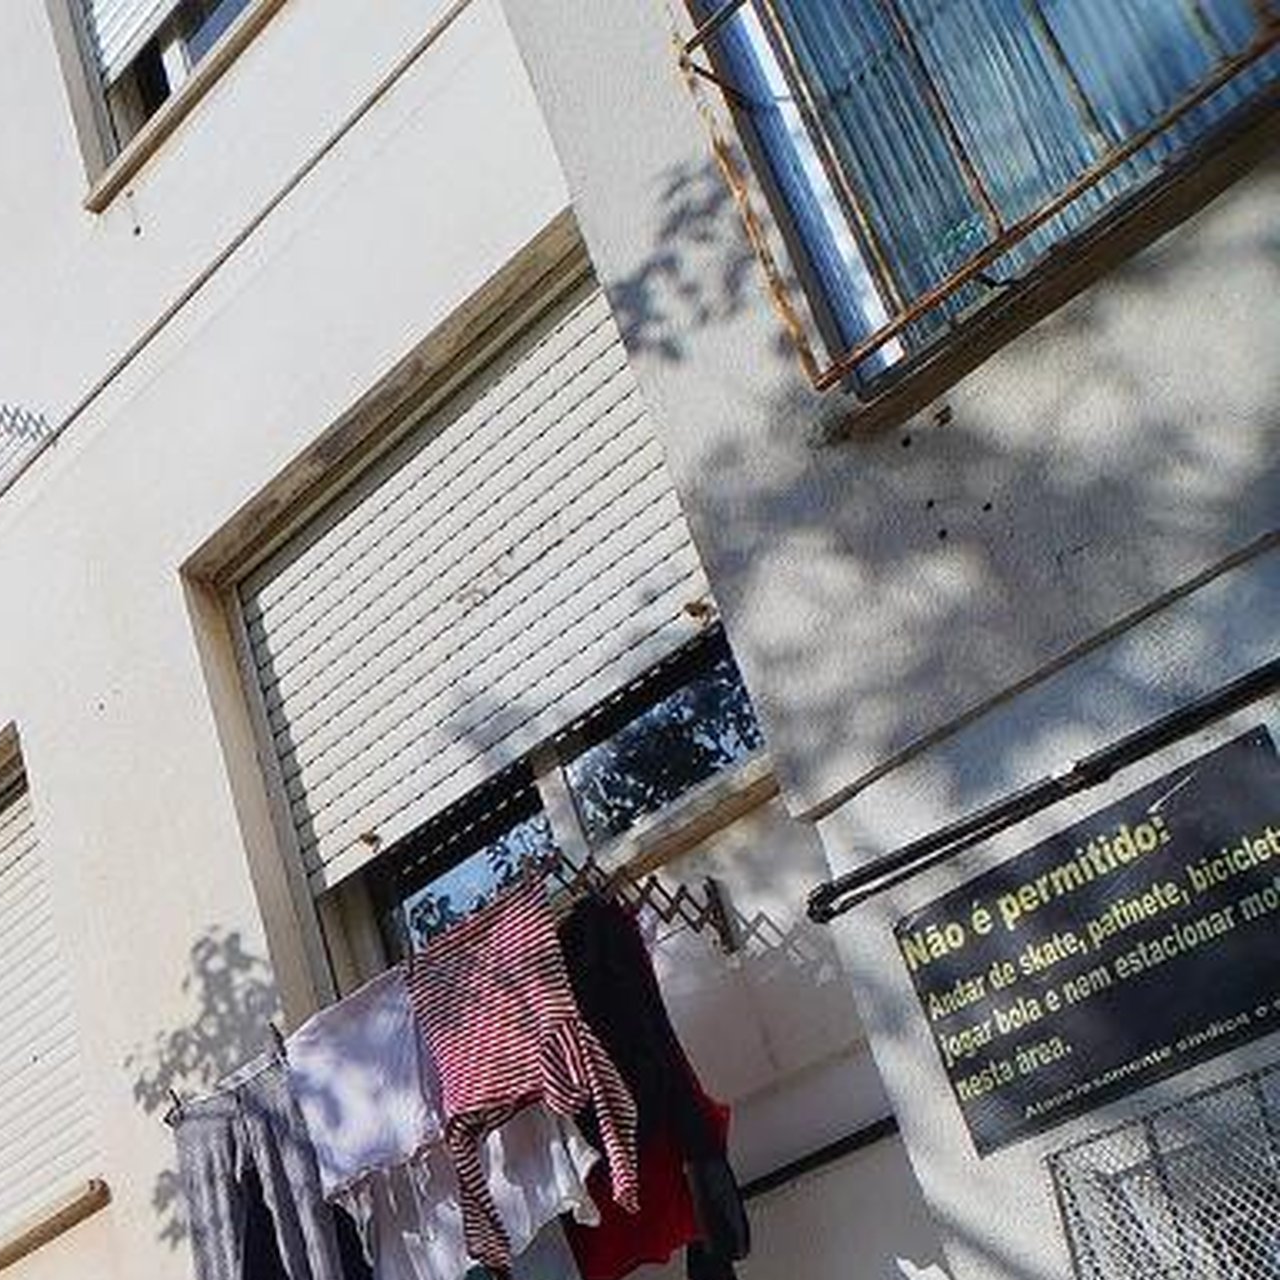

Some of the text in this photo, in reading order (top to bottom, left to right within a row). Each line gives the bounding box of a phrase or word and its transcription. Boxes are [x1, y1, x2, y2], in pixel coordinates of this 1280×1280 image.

[901, 816, 1171, 971] Não é permitido:
[928, 976, 986, 1021] Andar
[989, 961, 1017, 990] de
[1019, 931, 1088, 976] skate,
[1087, 881, 1190, 949] patinete,
[940, 1020, 993, 1068] jogar
[993, 997, 1043, 1034] bola
[1045, 989, 1061, 1012] e
[1062, 965, 1112, 1004] nem
[1114, 905, 1236, 979] estacionar
[957, 1036, 1073, 1101] nesta área.
